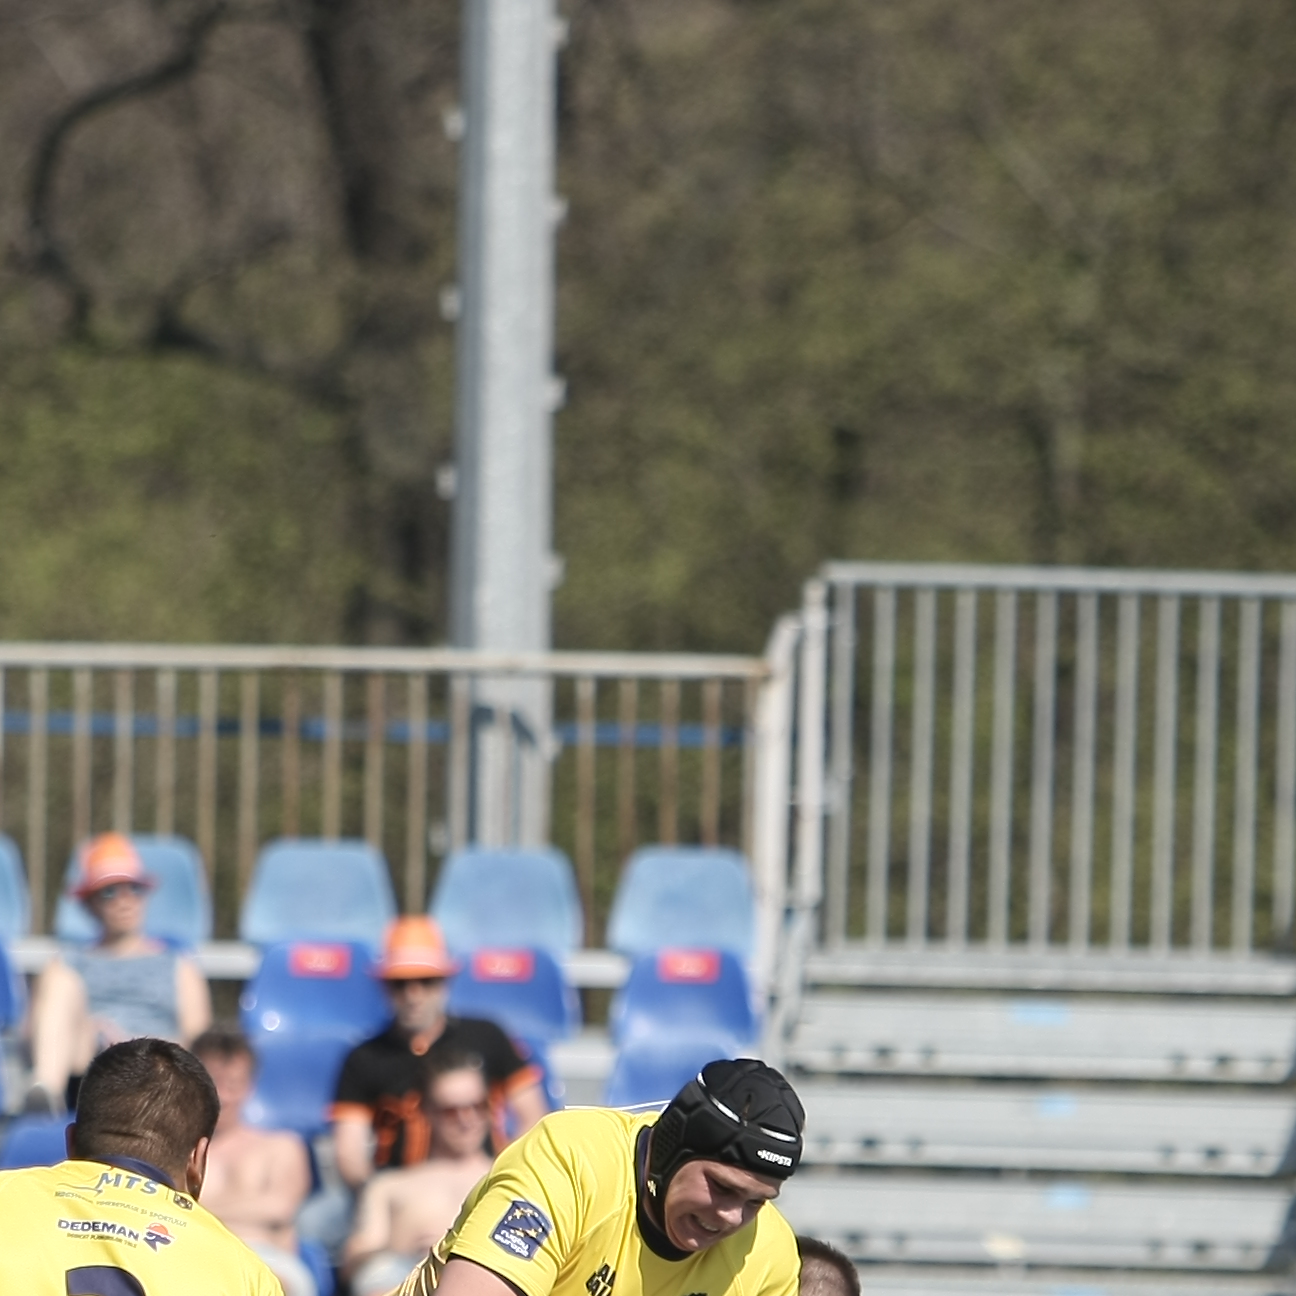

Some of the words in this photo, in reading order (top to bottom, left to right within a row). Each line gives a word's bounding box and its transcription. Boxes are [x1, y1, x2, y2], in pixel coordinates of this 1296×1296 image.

[95, 1172, 160, 1195] MTS
[58, 1219, 139, 1242] DEDEMAN
[500, 1229, 529, 1250] rugby
